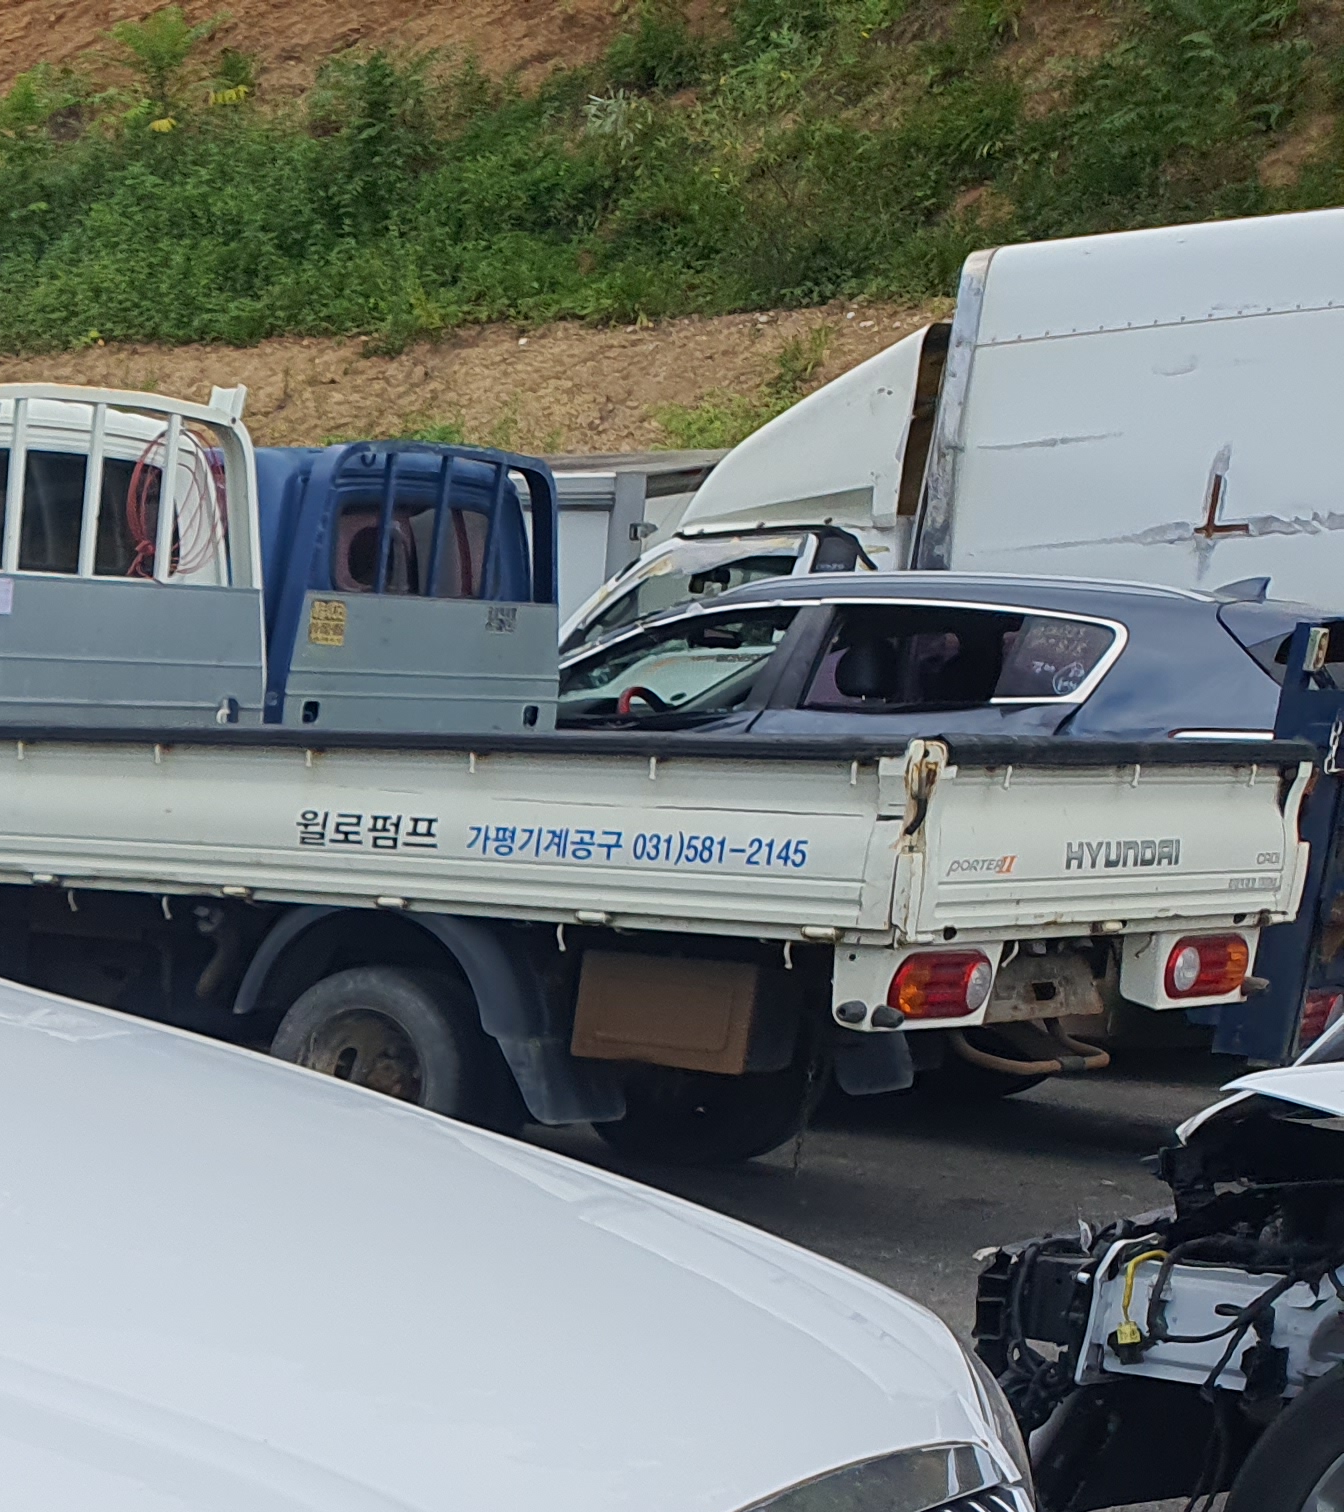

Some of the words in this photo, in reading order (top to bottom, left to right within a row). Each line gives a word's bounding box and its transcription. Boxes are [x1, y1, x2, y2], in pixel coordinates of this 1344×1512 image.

[296, 810, 438, 849] 윌로펌프
[466, 825, 623, 860] 가평기계공구
[632, 831, 809, 867] 031)581-2145
[1065, 839, 1180, 870] HYUNDAI
